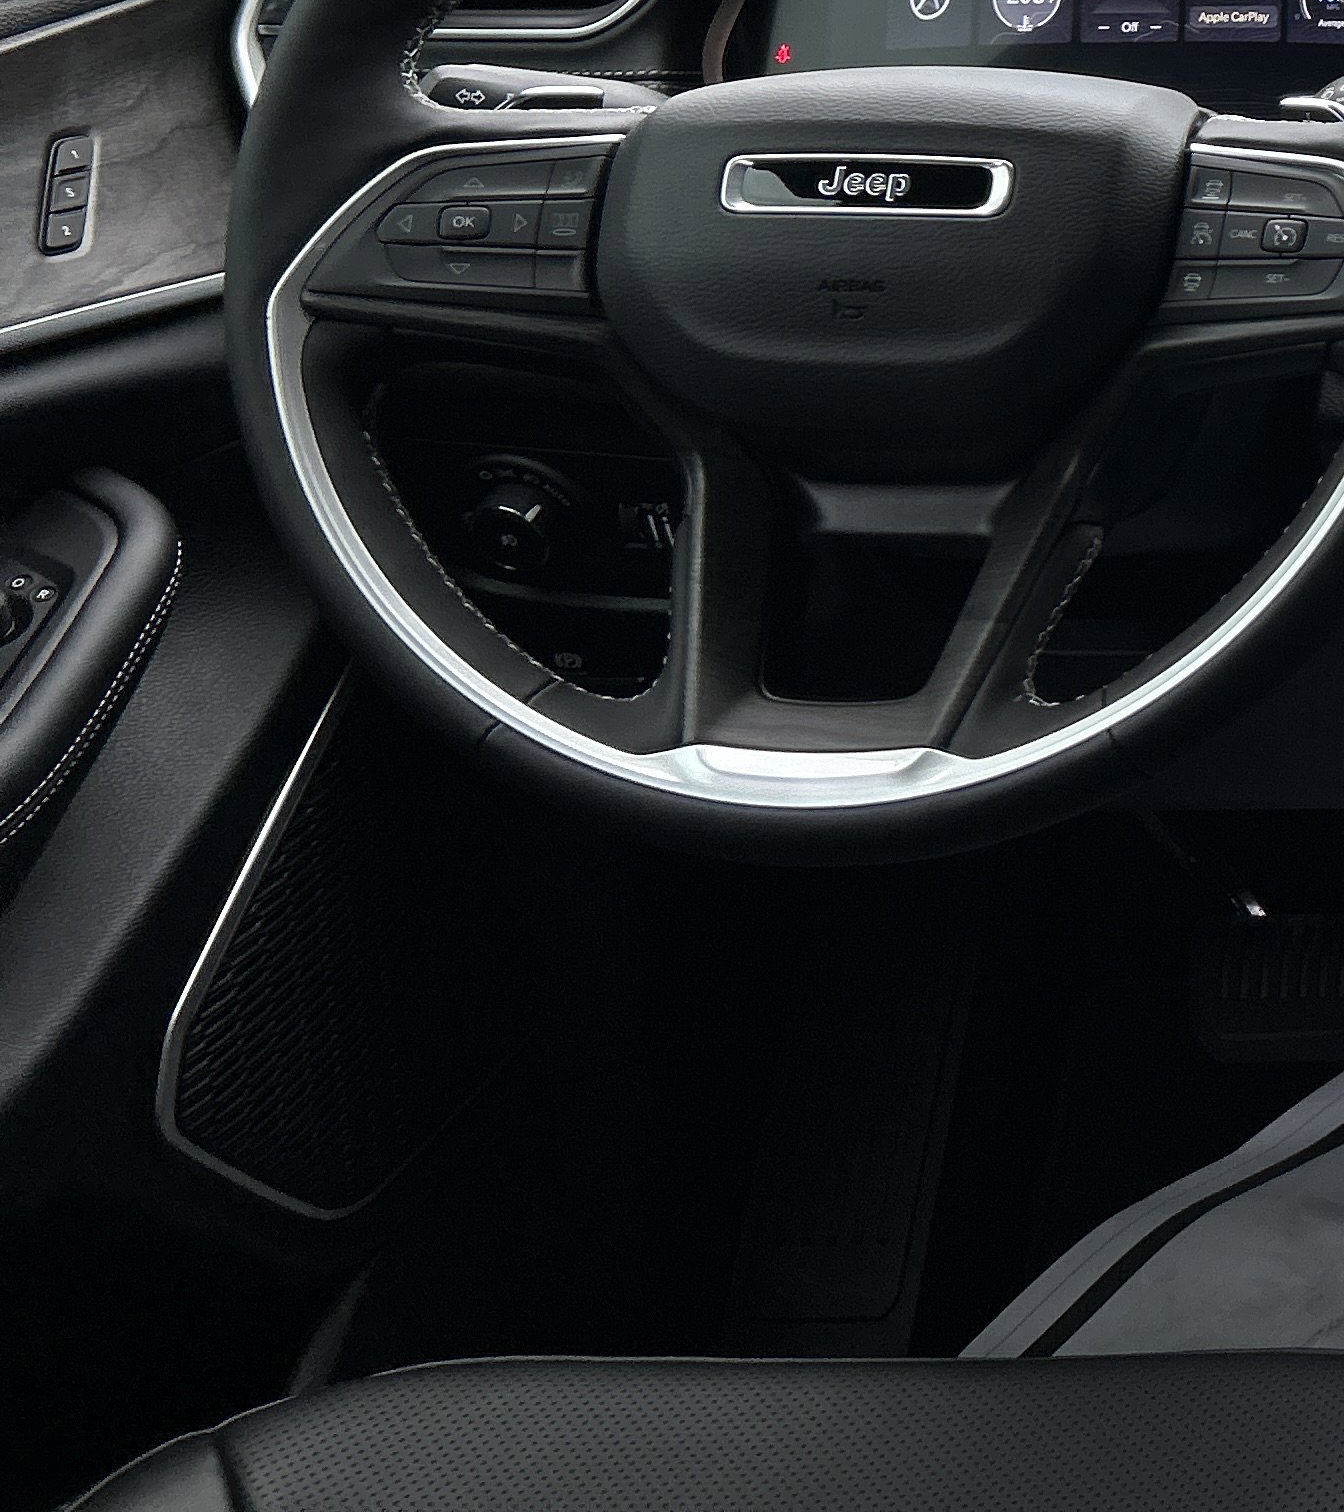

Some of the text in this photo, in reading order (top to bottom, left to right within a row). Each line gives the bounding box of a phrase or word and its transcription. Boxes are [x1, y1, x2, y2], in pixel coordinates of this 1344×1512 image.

[1198, 11, 1270, 24] Apple CarPlay
[1121, 21, 1140, 33] Off
[817, 165, 913, 202] Jeep
[452, 215, 475, 228] OK
